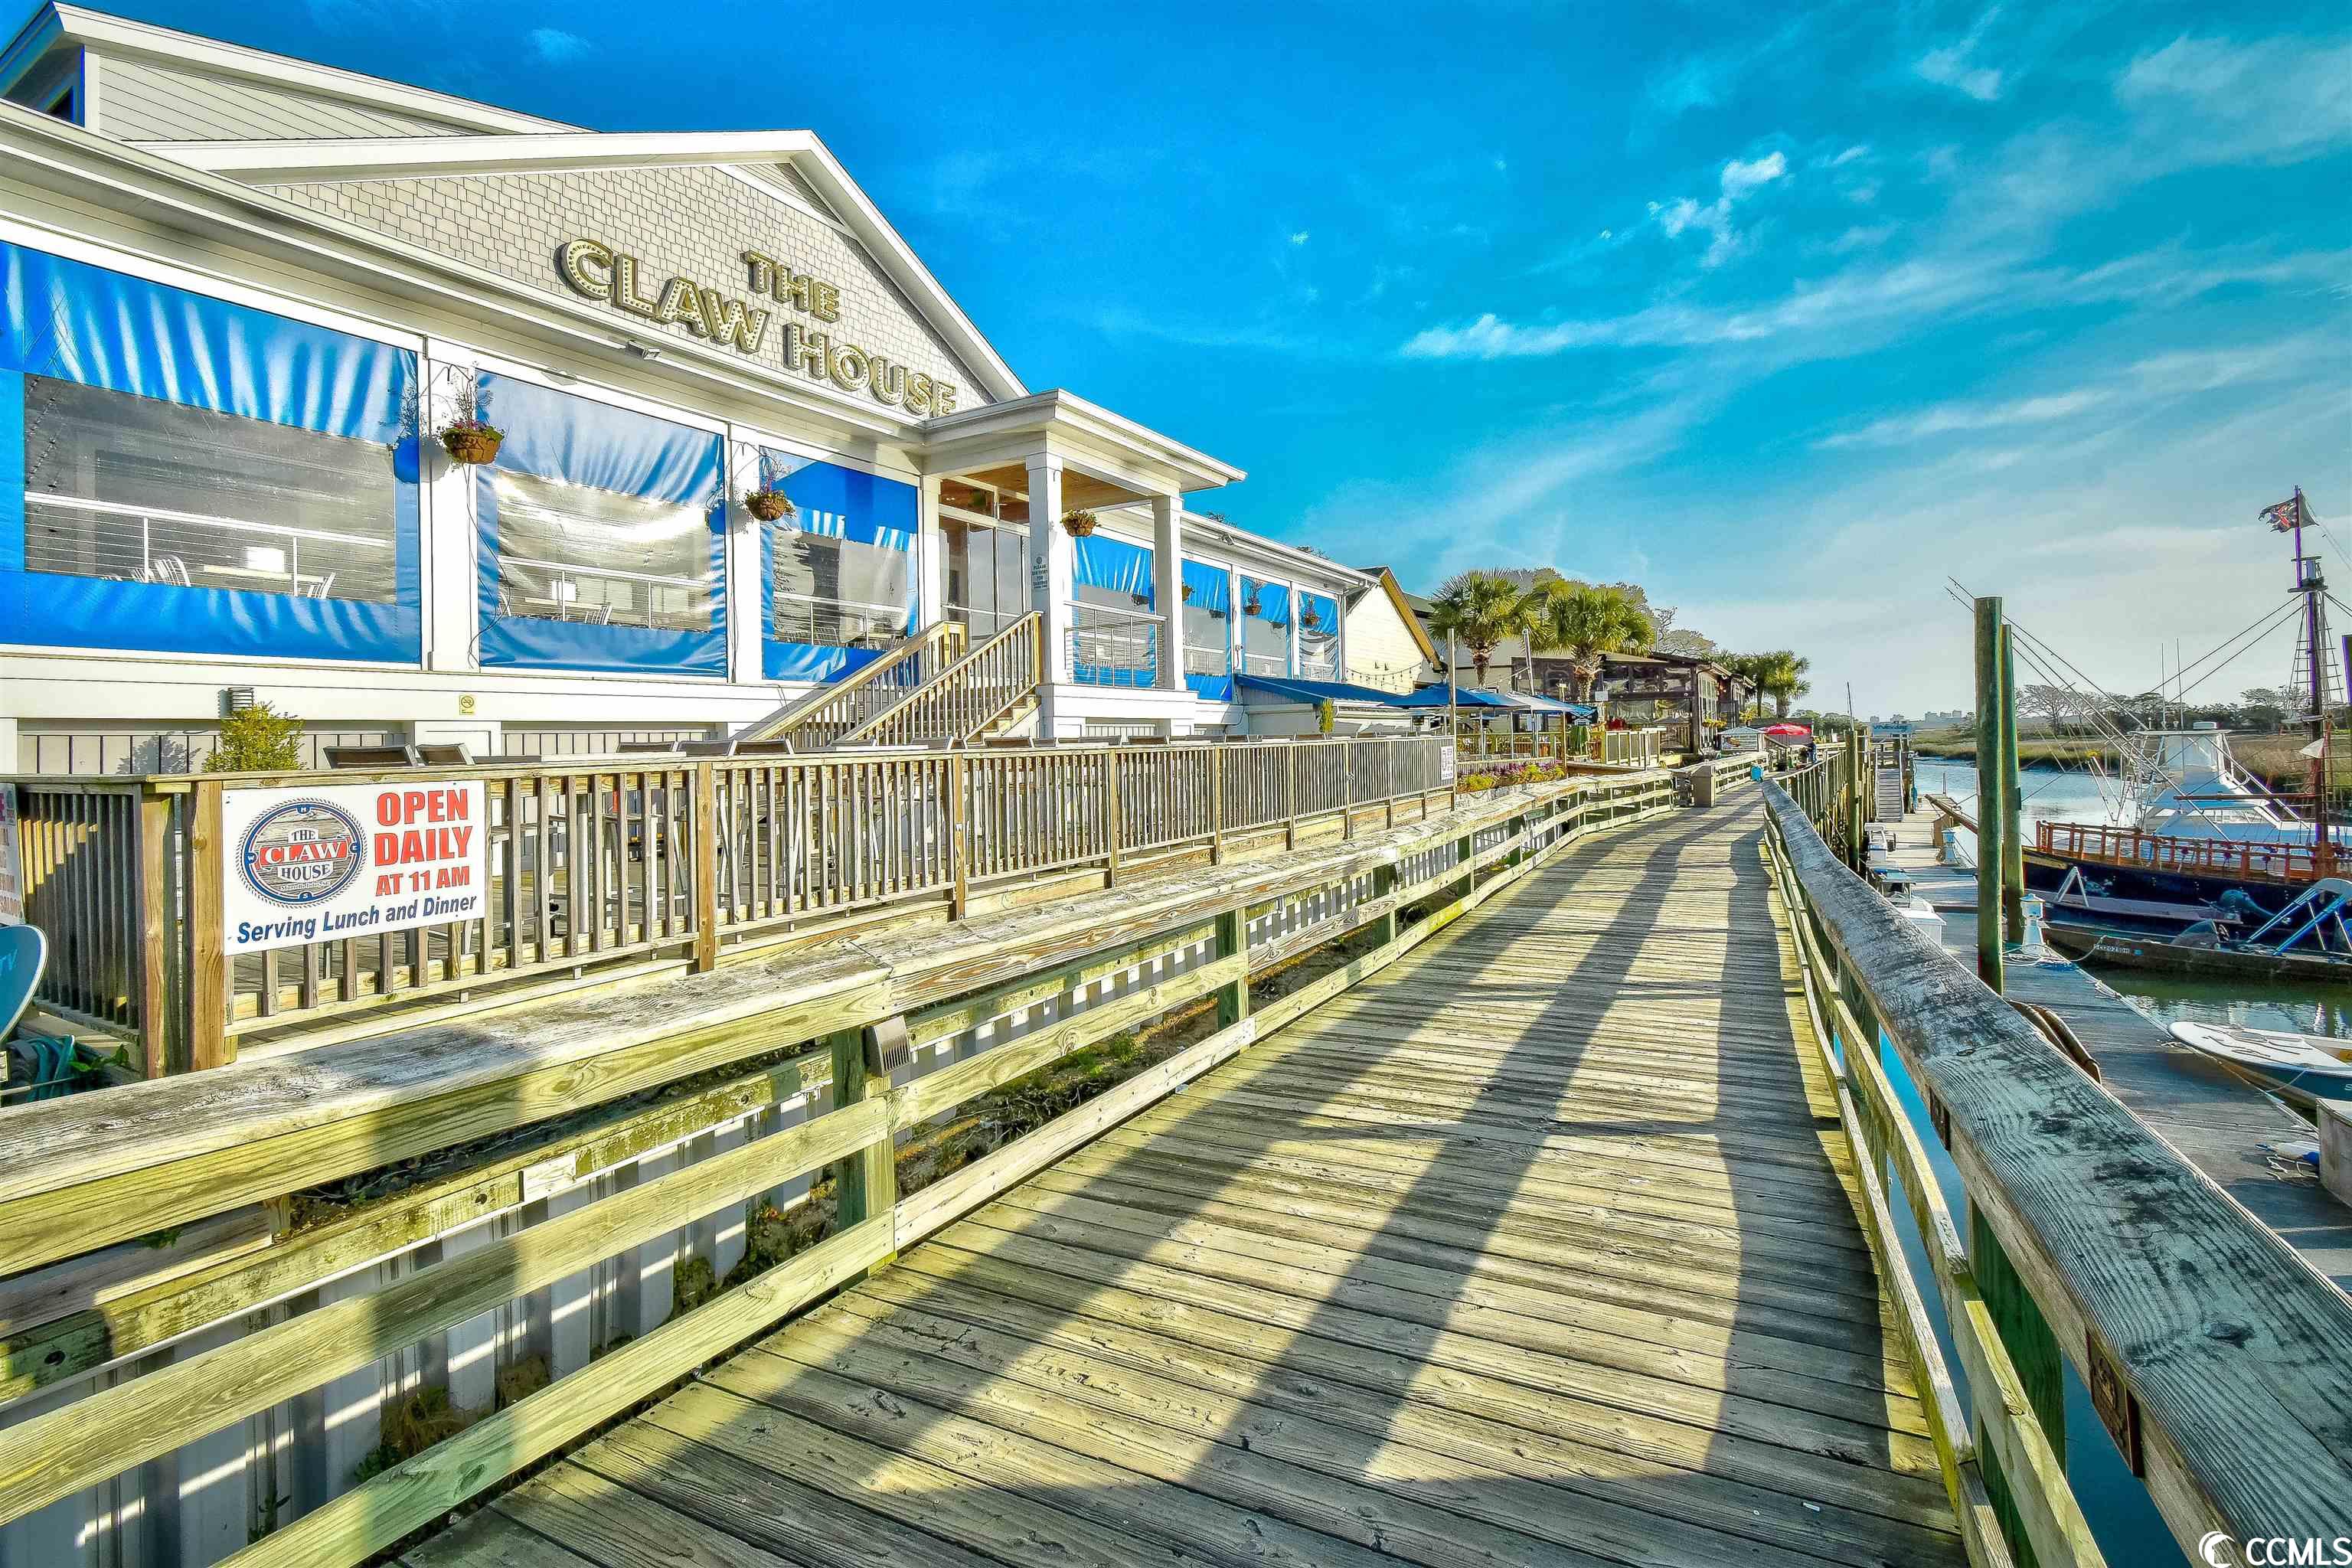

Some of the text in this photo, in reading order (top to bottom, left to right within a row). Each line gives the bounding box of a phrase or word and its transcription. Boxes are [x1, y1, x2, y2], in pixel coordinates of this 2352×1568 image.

[740, 250, 841, 323] THE
[556, 239, 956, 417] CLAW HOUSE
[377, 789, 468, 826] OPEN
[266, 841, 342, 864] CLAW
[292, 830, 315, 841] THE
[374, 826, 472, 867] DAILY
[282, 864, 330, 880] HOUSE
[376, 866, 470, 897] AT 11 AM
[237, 895, 477, 943] Serving Lunch and Dinner
